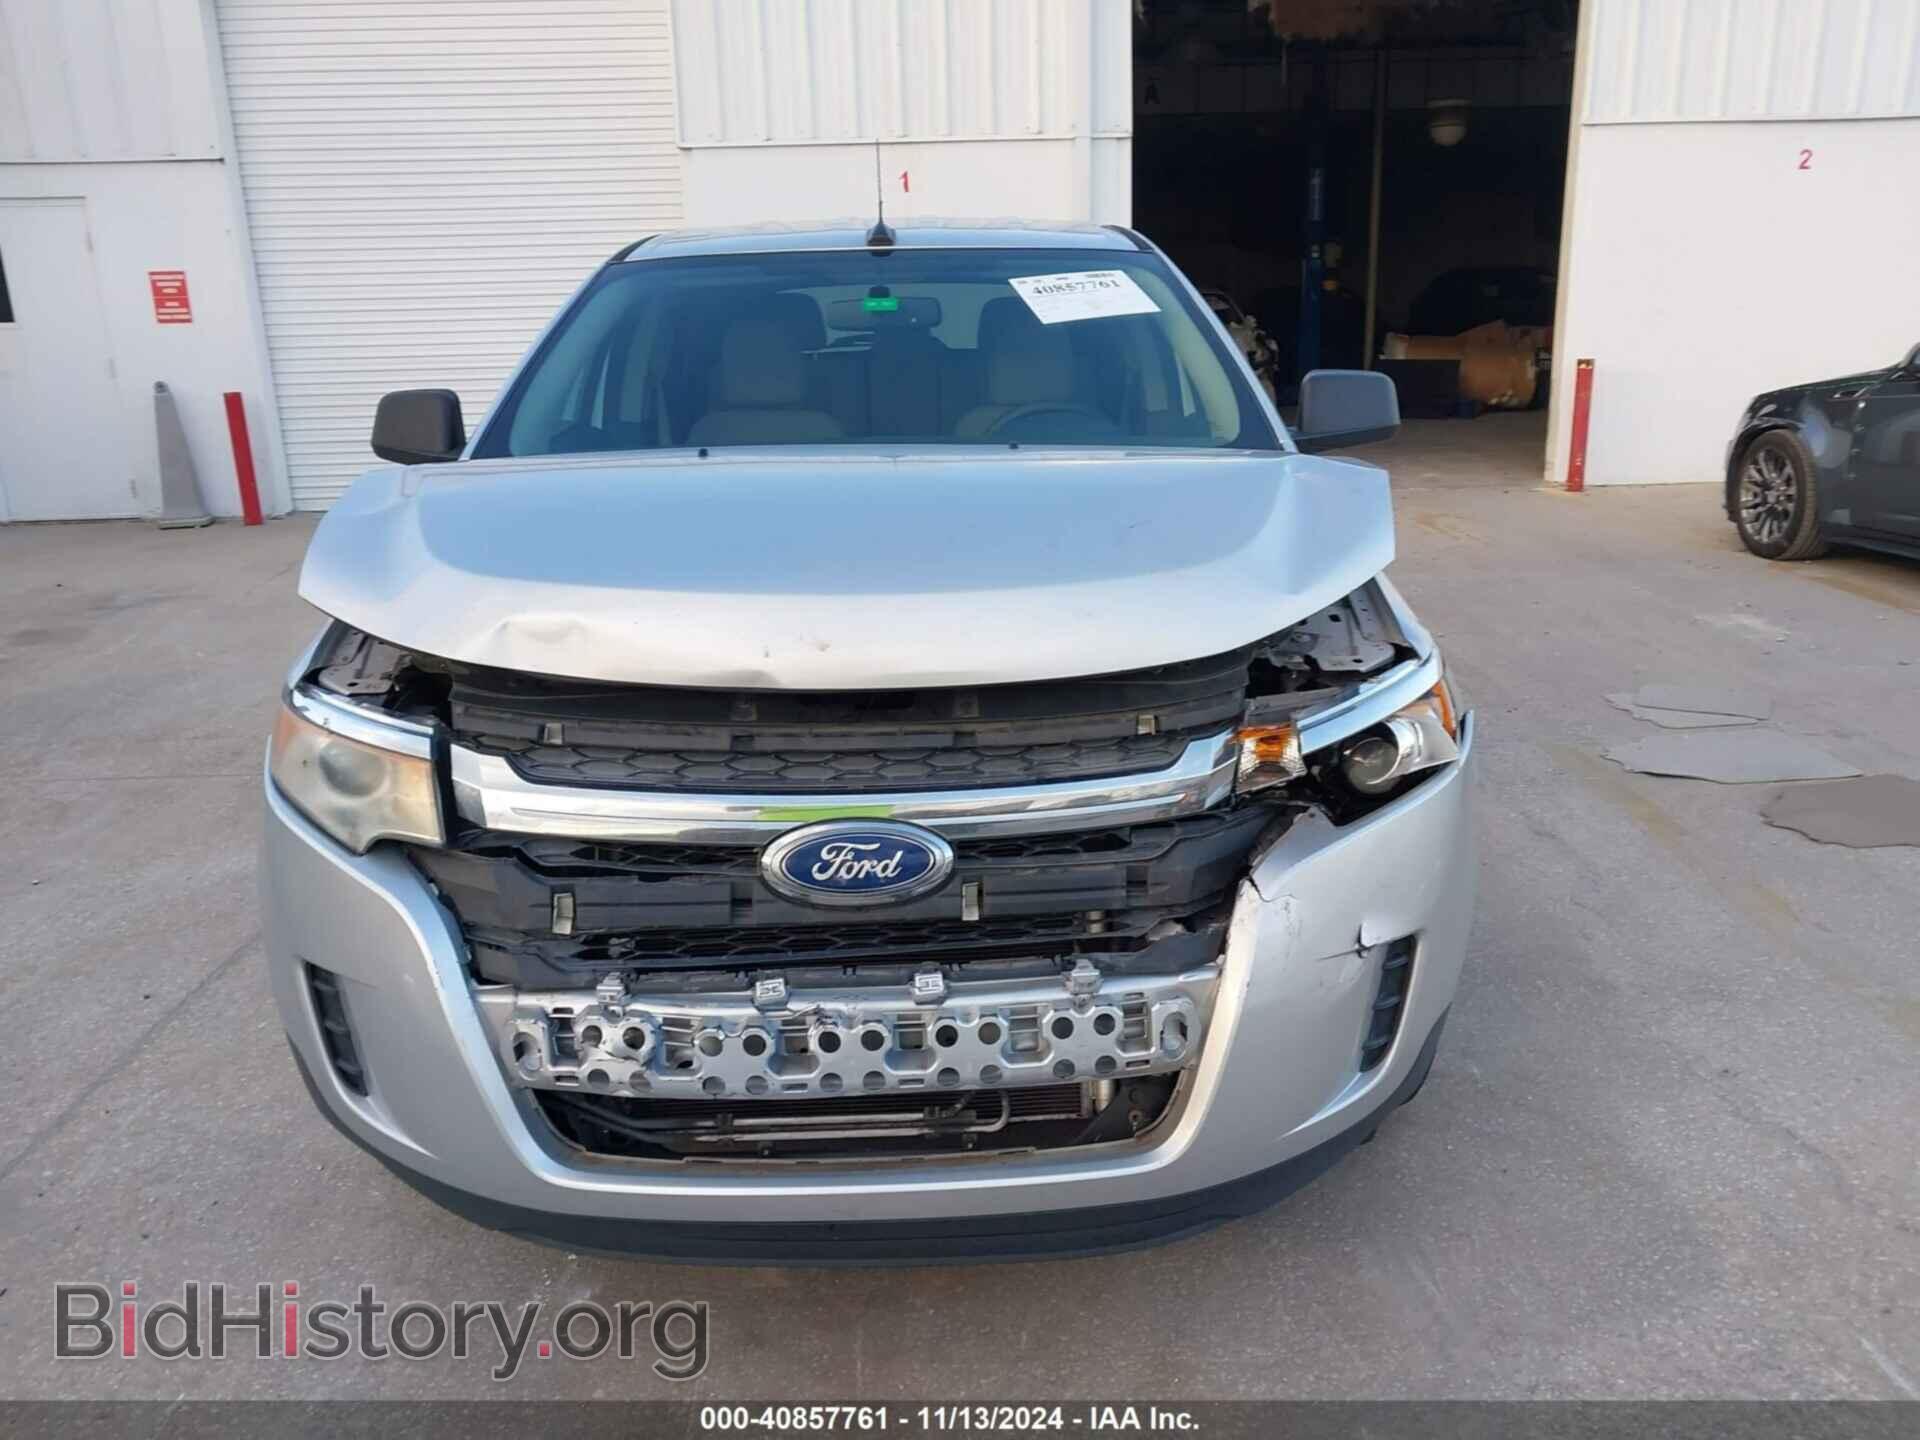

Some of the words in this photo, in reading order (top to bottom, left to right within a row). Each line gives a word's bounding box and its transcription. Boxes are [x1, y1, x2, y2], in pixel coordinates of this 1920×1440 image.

[1799, 149, 1813, 170] 2
[898, 170, 909, 192] 1
[1032, 279, 1121, 295] 40857761
[811, 842, 904, 881] Ford
